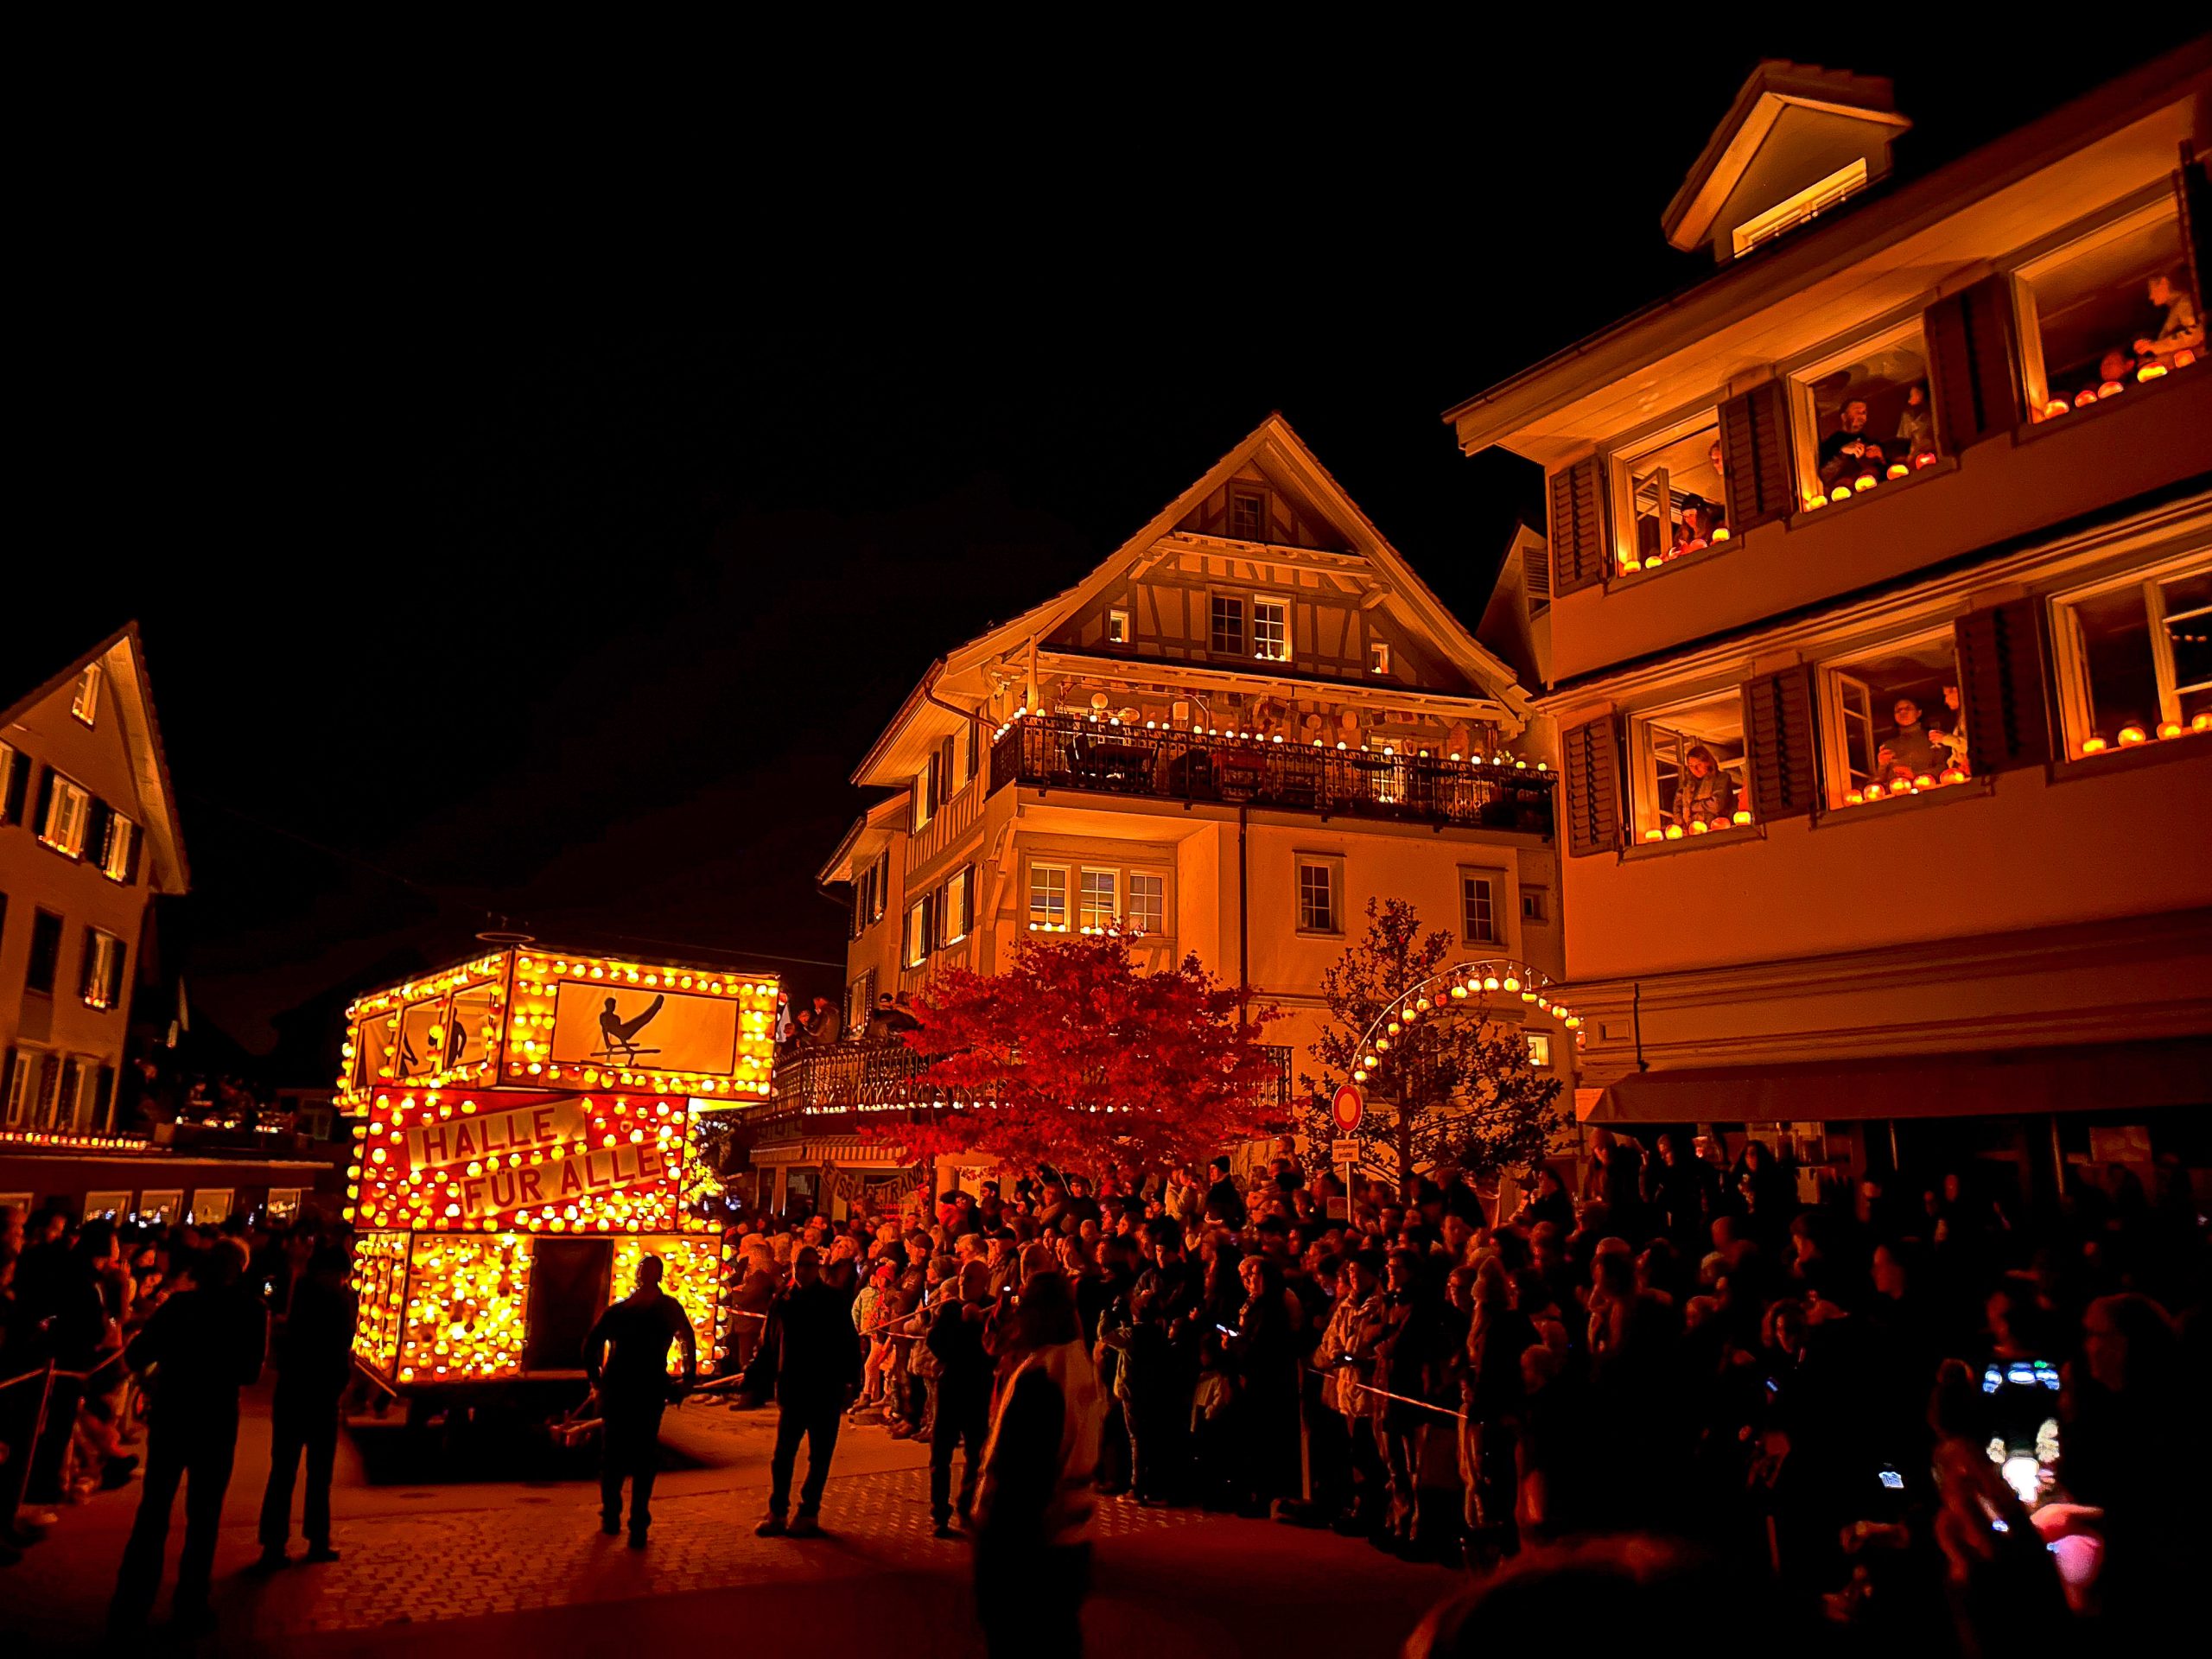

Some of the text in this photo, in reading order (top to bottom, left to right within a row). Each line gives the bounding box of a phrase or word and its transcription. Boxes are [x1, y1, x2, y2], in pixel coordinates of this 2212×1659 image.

[423, 1107, 557, 1163] HALLE
[464, 1142, 662, 1213] FÜR ALLE
